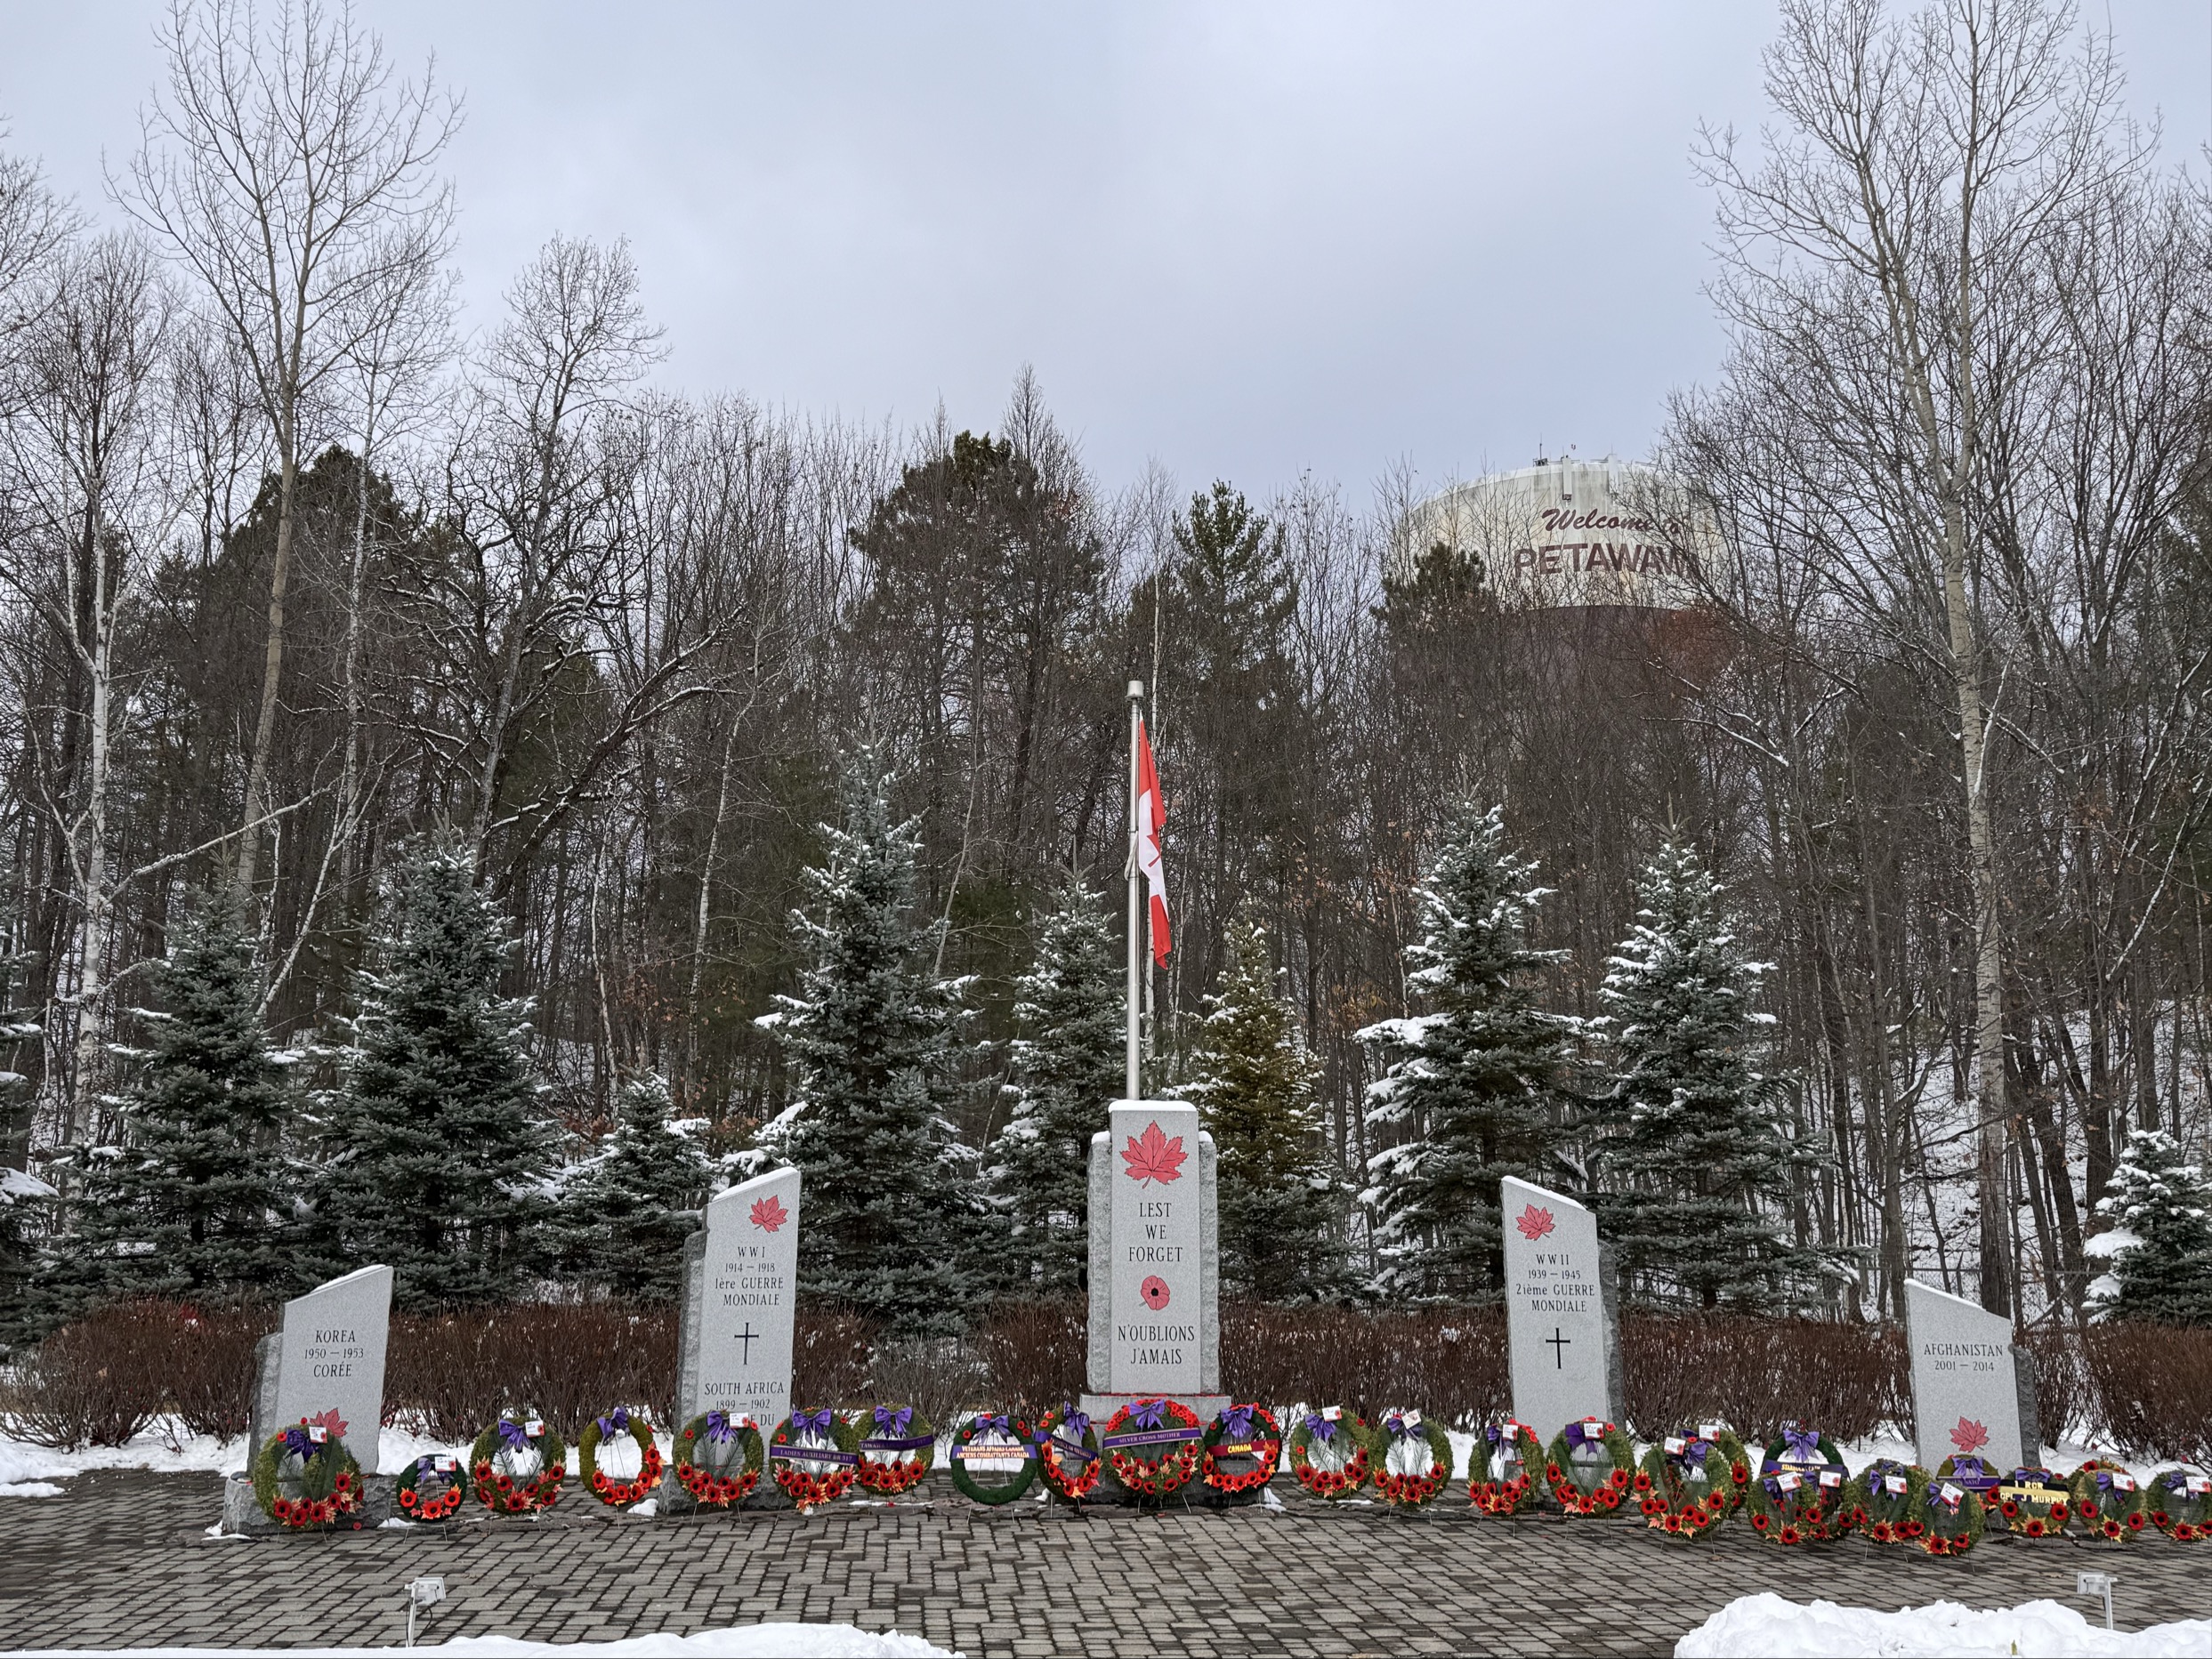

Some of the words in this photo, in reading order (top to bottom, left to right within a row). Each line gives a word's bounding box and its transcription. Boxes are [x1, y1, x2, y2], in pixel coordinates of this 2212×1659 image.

[1541, 508, 1654, 532] Welcome
[1514, 542, 1699, 578] PETAWAW
[1139, 1202, 1172, 1218] LEST
[1144, 1224, 1167, 1240] WE
[1128, 1245, 1183, 1262] FORGET
[725, 1262, 743, 1273] 1914
[758, 1262, 776, 1273] 1918
[1528, 1269, 1547, 1280] 1939
[1562, 1269, 1581, 1280] 1945
[715, 1276, 736, 1290] 1ère
[741, 1276, 784, 1290] GUERRE
[1515, 1284, 1548, 1296] 2ième
[1553, 1284, 1595, 1297] GUERRE
[723, 1293, 779, 1307] MONDIALE
[1531, 1300, 1587, 1313] MONDIALE
[315, 1329, 356, 1344] KOREA
[1118, 1323, 1195, 1342] N'OUBLIONS
[304, 1348, 327, 1360] 1950
[343, 1347, 364, 1359] 1953
[1130, 1347, 1183, 1365] J'AMAIS
[1924, 1342, 2003, 1357] AFGHANISTAN
[313, 1361, 352, 1378] CORÉE
[1934, 1359, 1957, 1372] 2001
[1973, 1360, 1995, 1372] 2014
[704, 1381, 740, 1396] SOUTH
[745, 1381, 785, 1395] AFRICA
[715, 1399, 737, 1411] 1899
[751, 1398, 771, 1410] 1902
[760, 1413, 775, 1426] DU
[1157, 1432, 1181, 1440] MOTHER
[780, 1449, 801, 1457] LADIES
[801, 1451, 832, 1460] AUXILIARY
[1227, 1443, 1253, 1454] CANADA
[2014, 1480, 2019, 1488] 1
[2024, 1480, 2044, 1490] RCR
[2031, 1494, 2068, 1506] MURPHY
